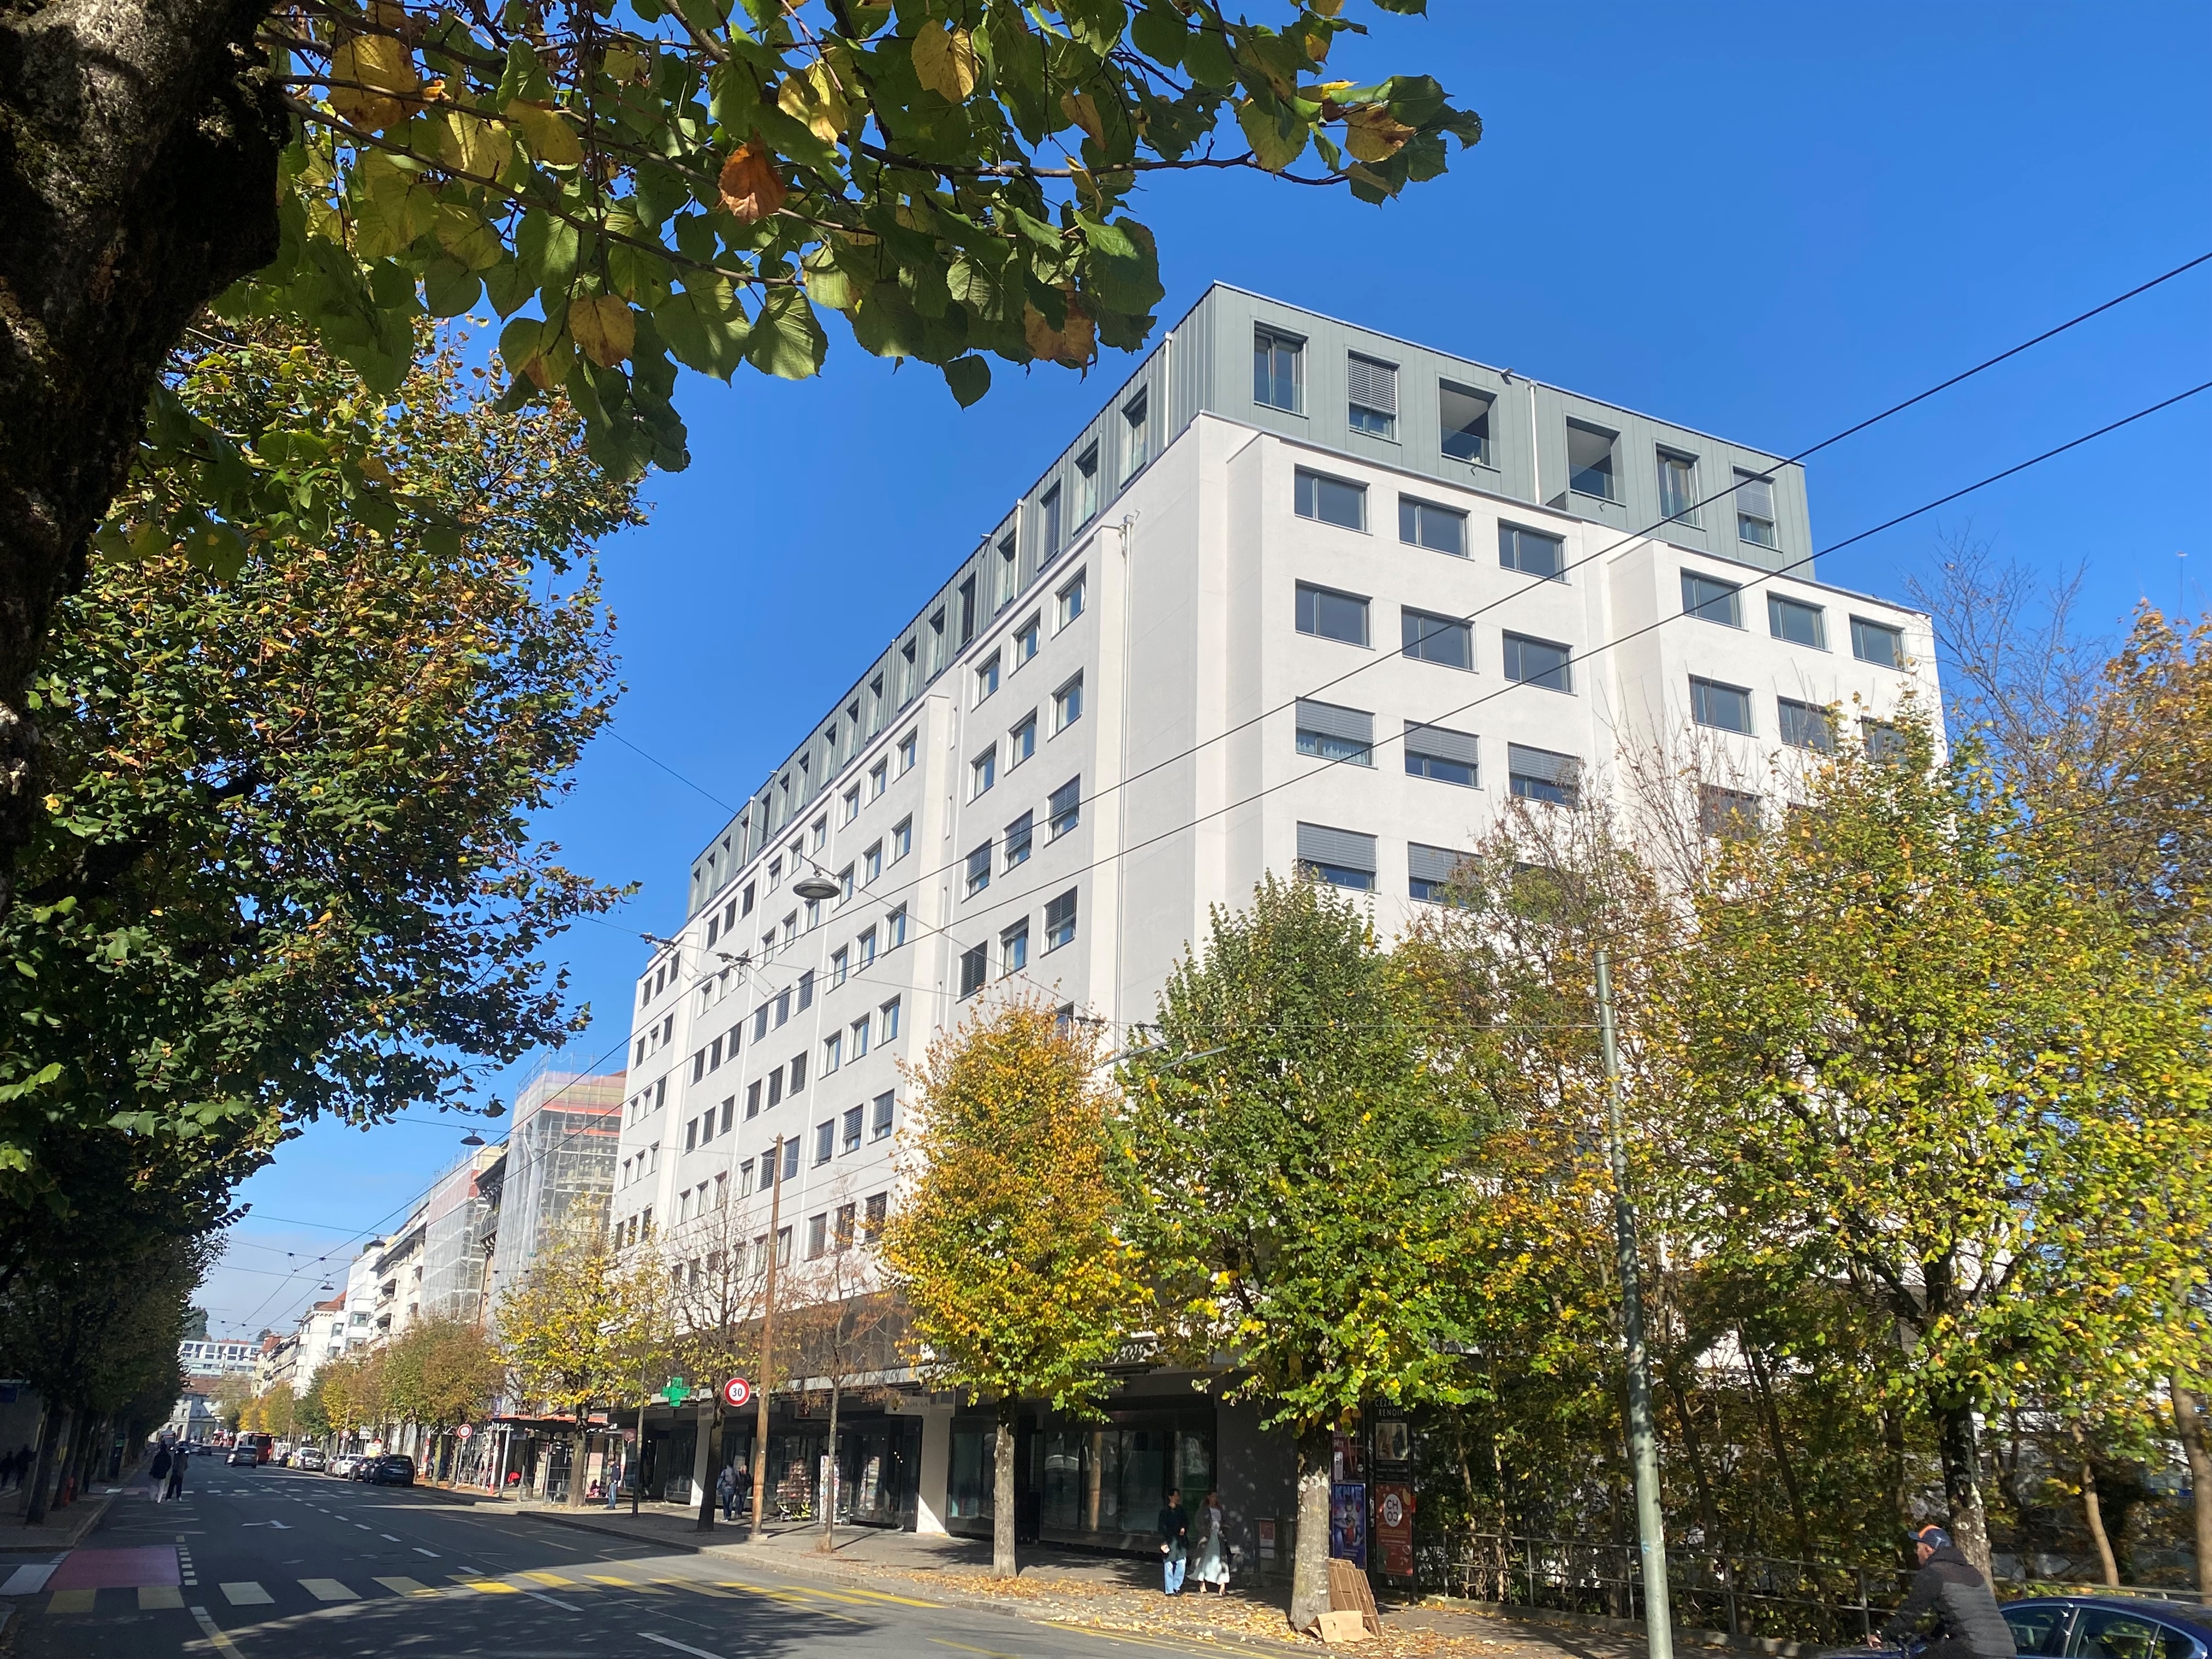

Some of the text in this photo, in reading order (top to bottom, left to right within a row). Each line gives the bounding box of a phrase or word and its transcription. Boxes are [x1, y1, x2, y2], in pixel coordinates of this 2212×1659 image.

[732, 1388, 743, 1397] 30
[1378, 1408, 1404, 1417] RENOIR
[1335, 1486, 1362, 1501] KNIE
[1387, 1499, 1399, 1510] CH
